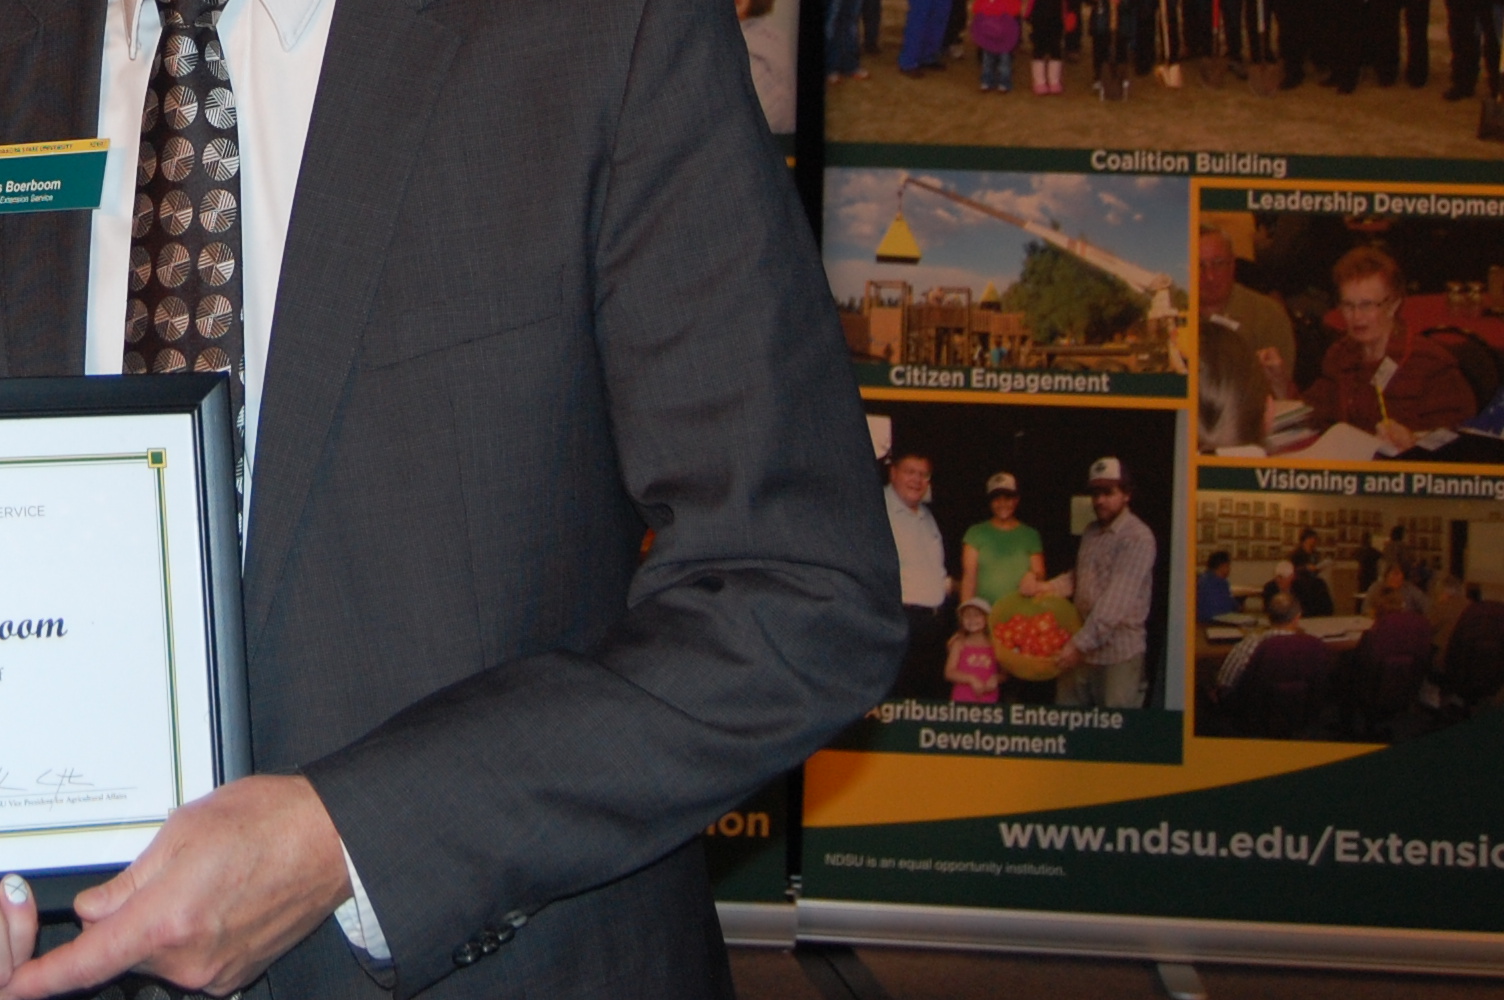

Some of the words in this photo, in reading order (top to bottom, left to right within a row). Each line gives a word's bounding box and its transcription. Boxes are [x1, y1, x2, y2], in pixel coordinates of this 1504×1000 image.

[1090, 150, 1189, 173] Coalition
[1195, 152, 1287, 178] Building
[0, 195, 29, 204] Extension
[30, 193, 54, 203] Service
[5, 179, 61, 193] Boerboom
[1247, 189, 1367, 215] Leadership
[889, 365, 965, 387] Citizen
[971, 368, 1111, 393] Engagement
[1255, 468, 1358, 496] Visioning
[1363, 473, 1405, 493] and
[1412, 474, 1504, 500] Planning
[1010, 705, 1123, 730] Enterprise
[919, 728, 1066, 755] Development
[824, 853, 864, 867] NDSU
[866, 856, 877, 868] is
[881, 857, 895, 868] an
[898, 858, 932, 872] equal
[933, 859, 1002, 875] opportunity
